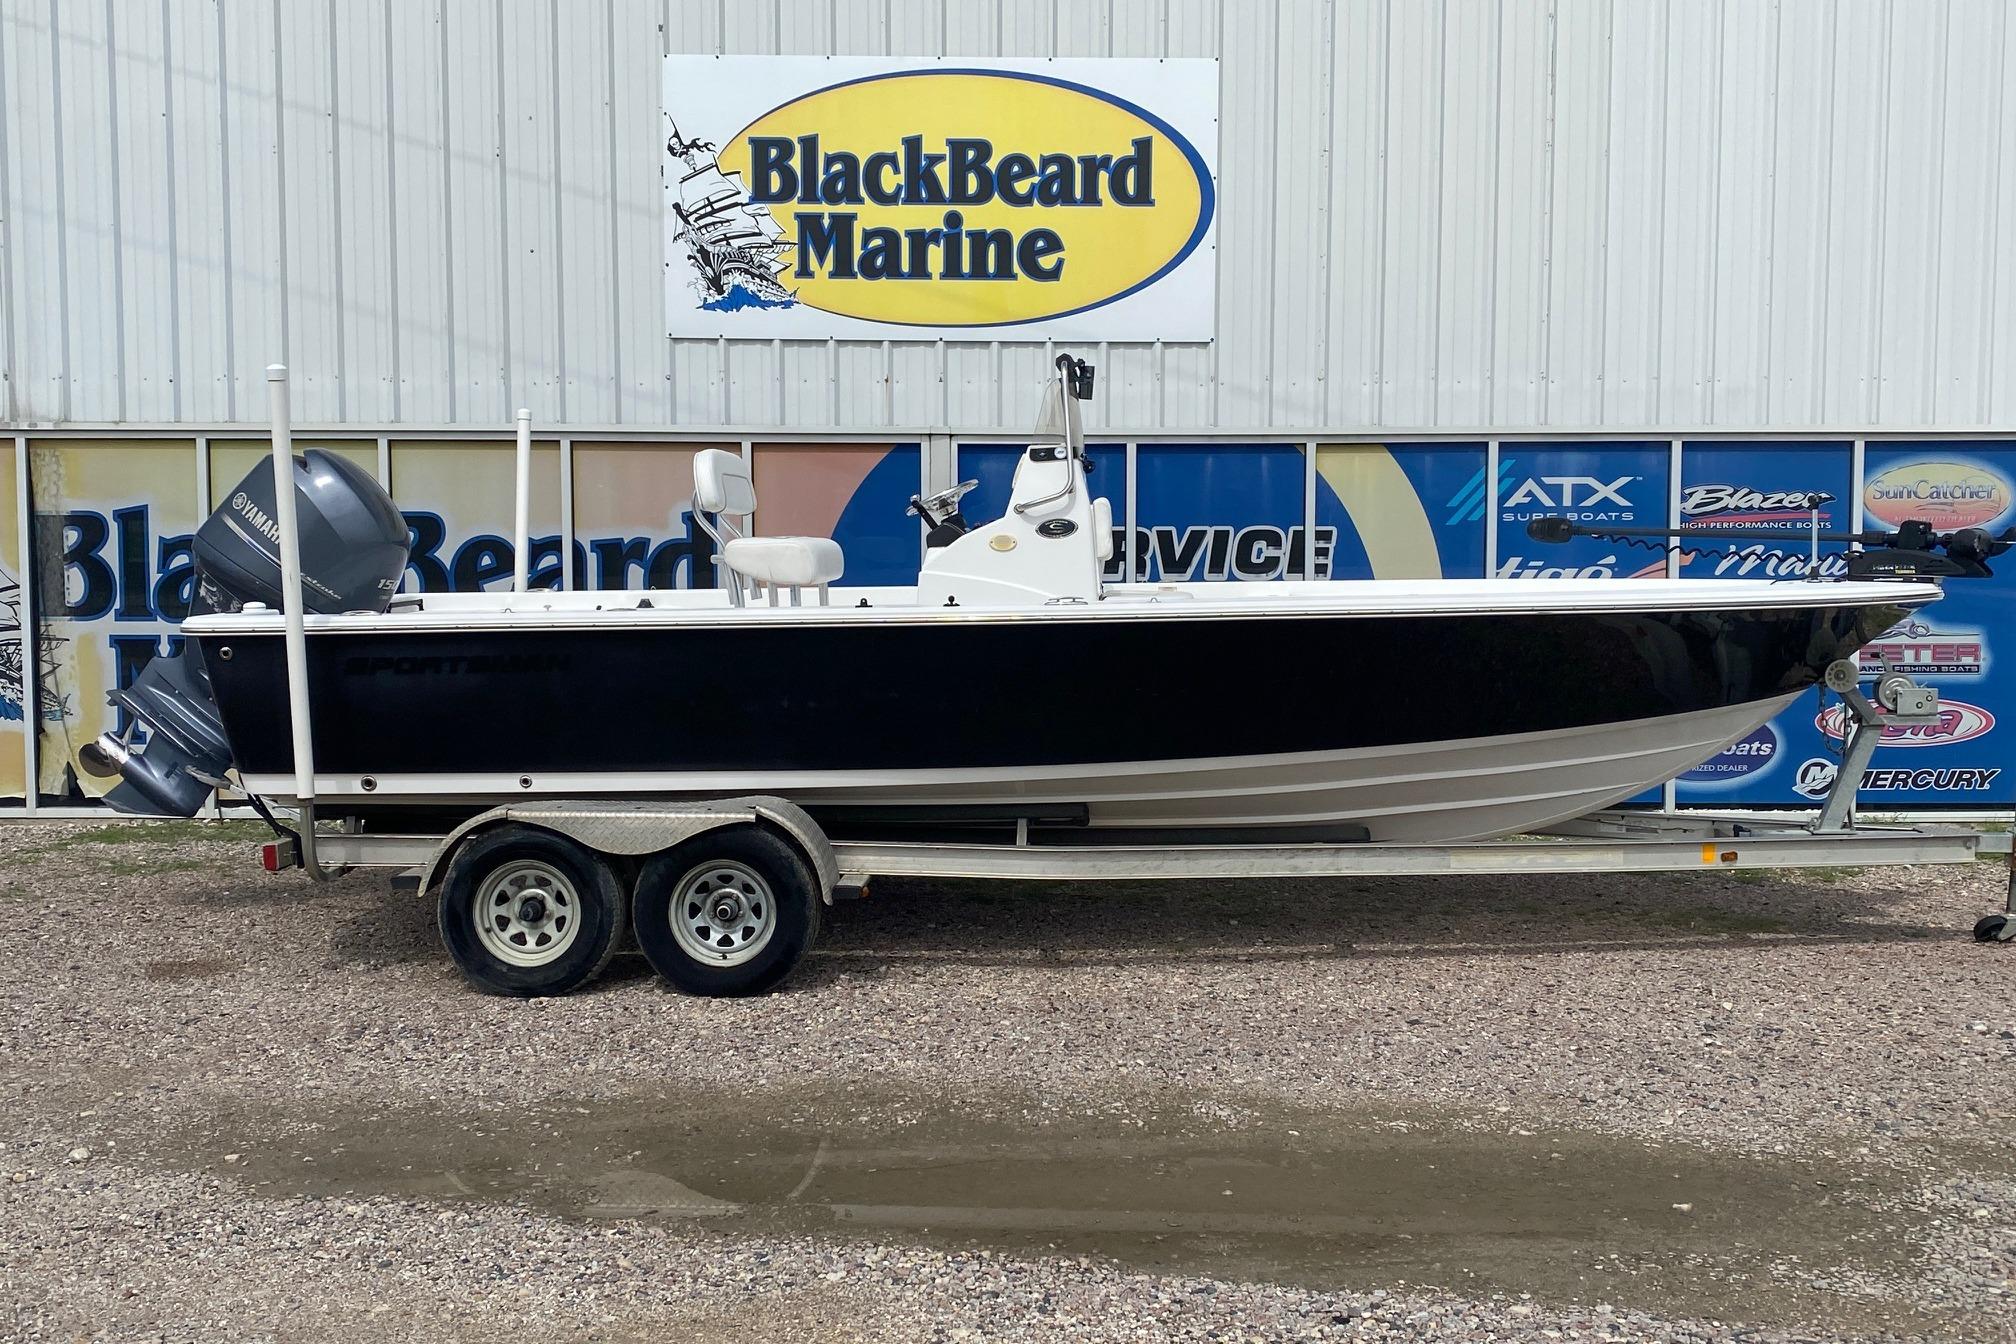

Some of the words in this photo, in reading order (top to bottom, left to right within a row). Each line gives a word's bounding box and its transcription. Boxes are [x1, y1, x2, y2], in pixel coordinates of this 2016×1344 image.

[747, 133, 1155, 207] BlackBeard
[794, 210, 1066, 282] Marine
[1503, 476, 1634, 507] ATX
[1872, 480, 1996, 500] SunCatcher
[241, 499, 280, 545] YAMAH
[1566, 512, 1634, 521] BOATS
[1710, 521, 1793, 529] PERFORMANCE
[1103, 525, 1338, 581] RVICE
[1859, 643, 1981, 662] EETER
[1722, 741, 1773, 755] oats
[1717, 764, 1748, 772] DEALER
